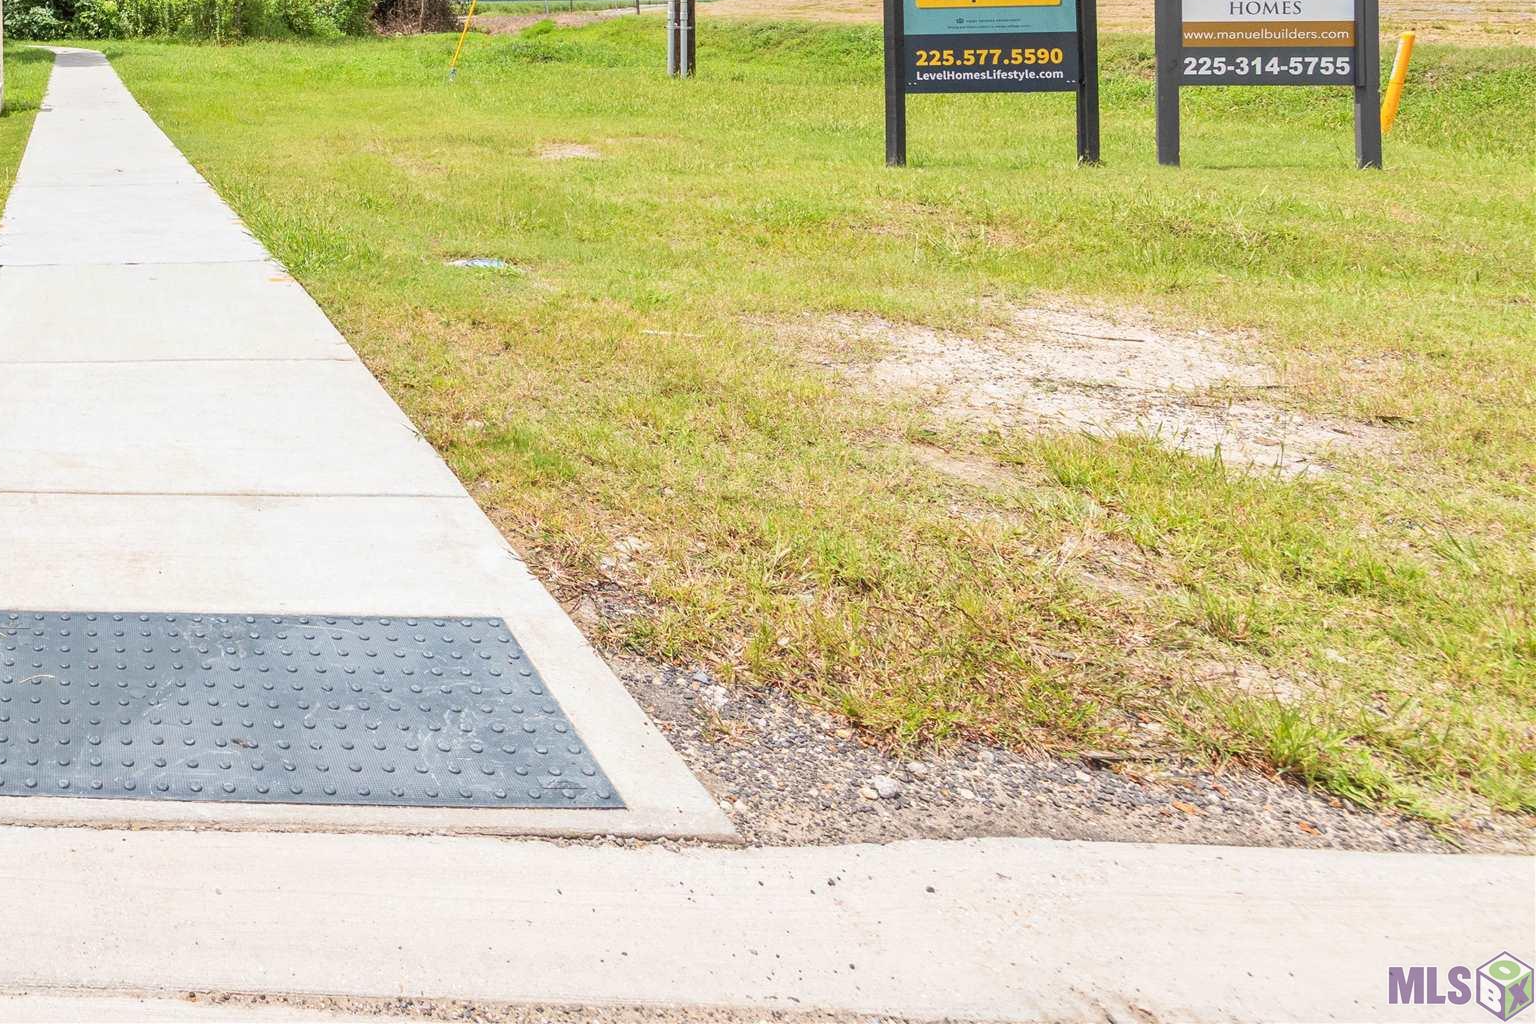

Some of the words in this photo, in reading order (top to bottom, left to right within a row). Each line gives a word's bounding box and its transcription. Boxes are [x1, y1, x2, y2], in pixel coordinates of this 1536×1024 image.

[1229, 0, 1302, 16] HOMES
[1183, 28, 1349, 41] www.manuelbuilders.com
[915, 47, 1064, 67] 225.577.5590
[1183, 56, 1351, 76] 225-314-5755
[916, 69, 1064, 81] LevelHomesLifestyle.com
